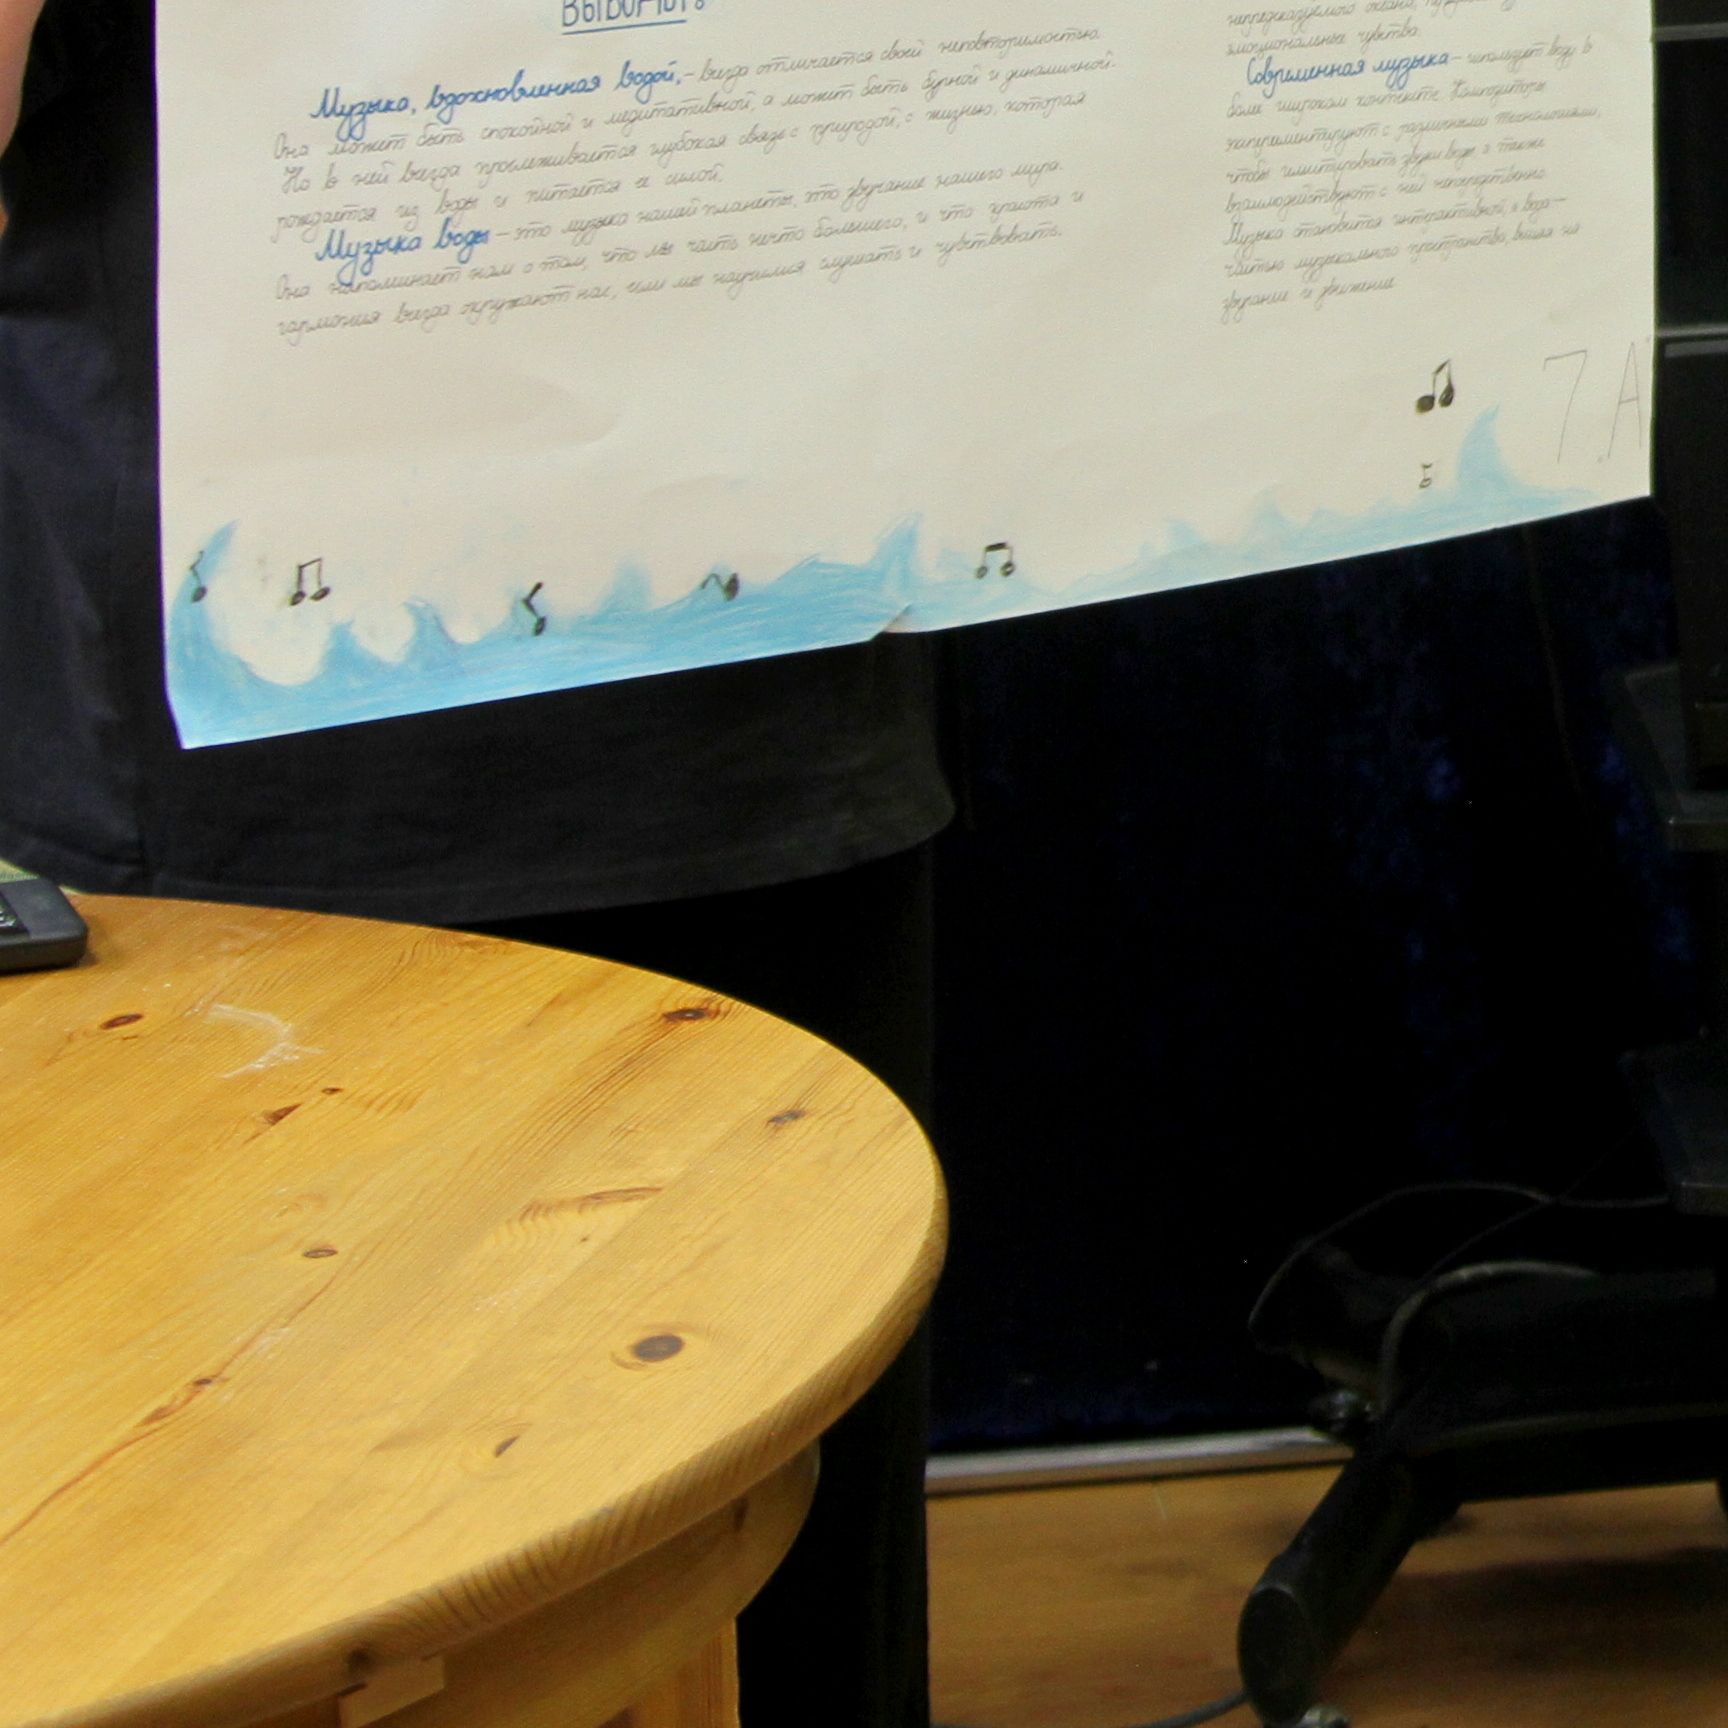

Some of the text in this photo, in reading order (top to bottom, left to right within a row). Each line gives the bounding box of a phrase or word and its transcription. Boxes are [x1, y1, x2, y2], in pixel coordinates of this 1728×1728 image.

[1247, 51, 1450, 100] Современная музыка
[310, 87, 417, 141] Музыка,
[315, 228, 423, 286] Музыка
[434, 217, 491, 263] воды
